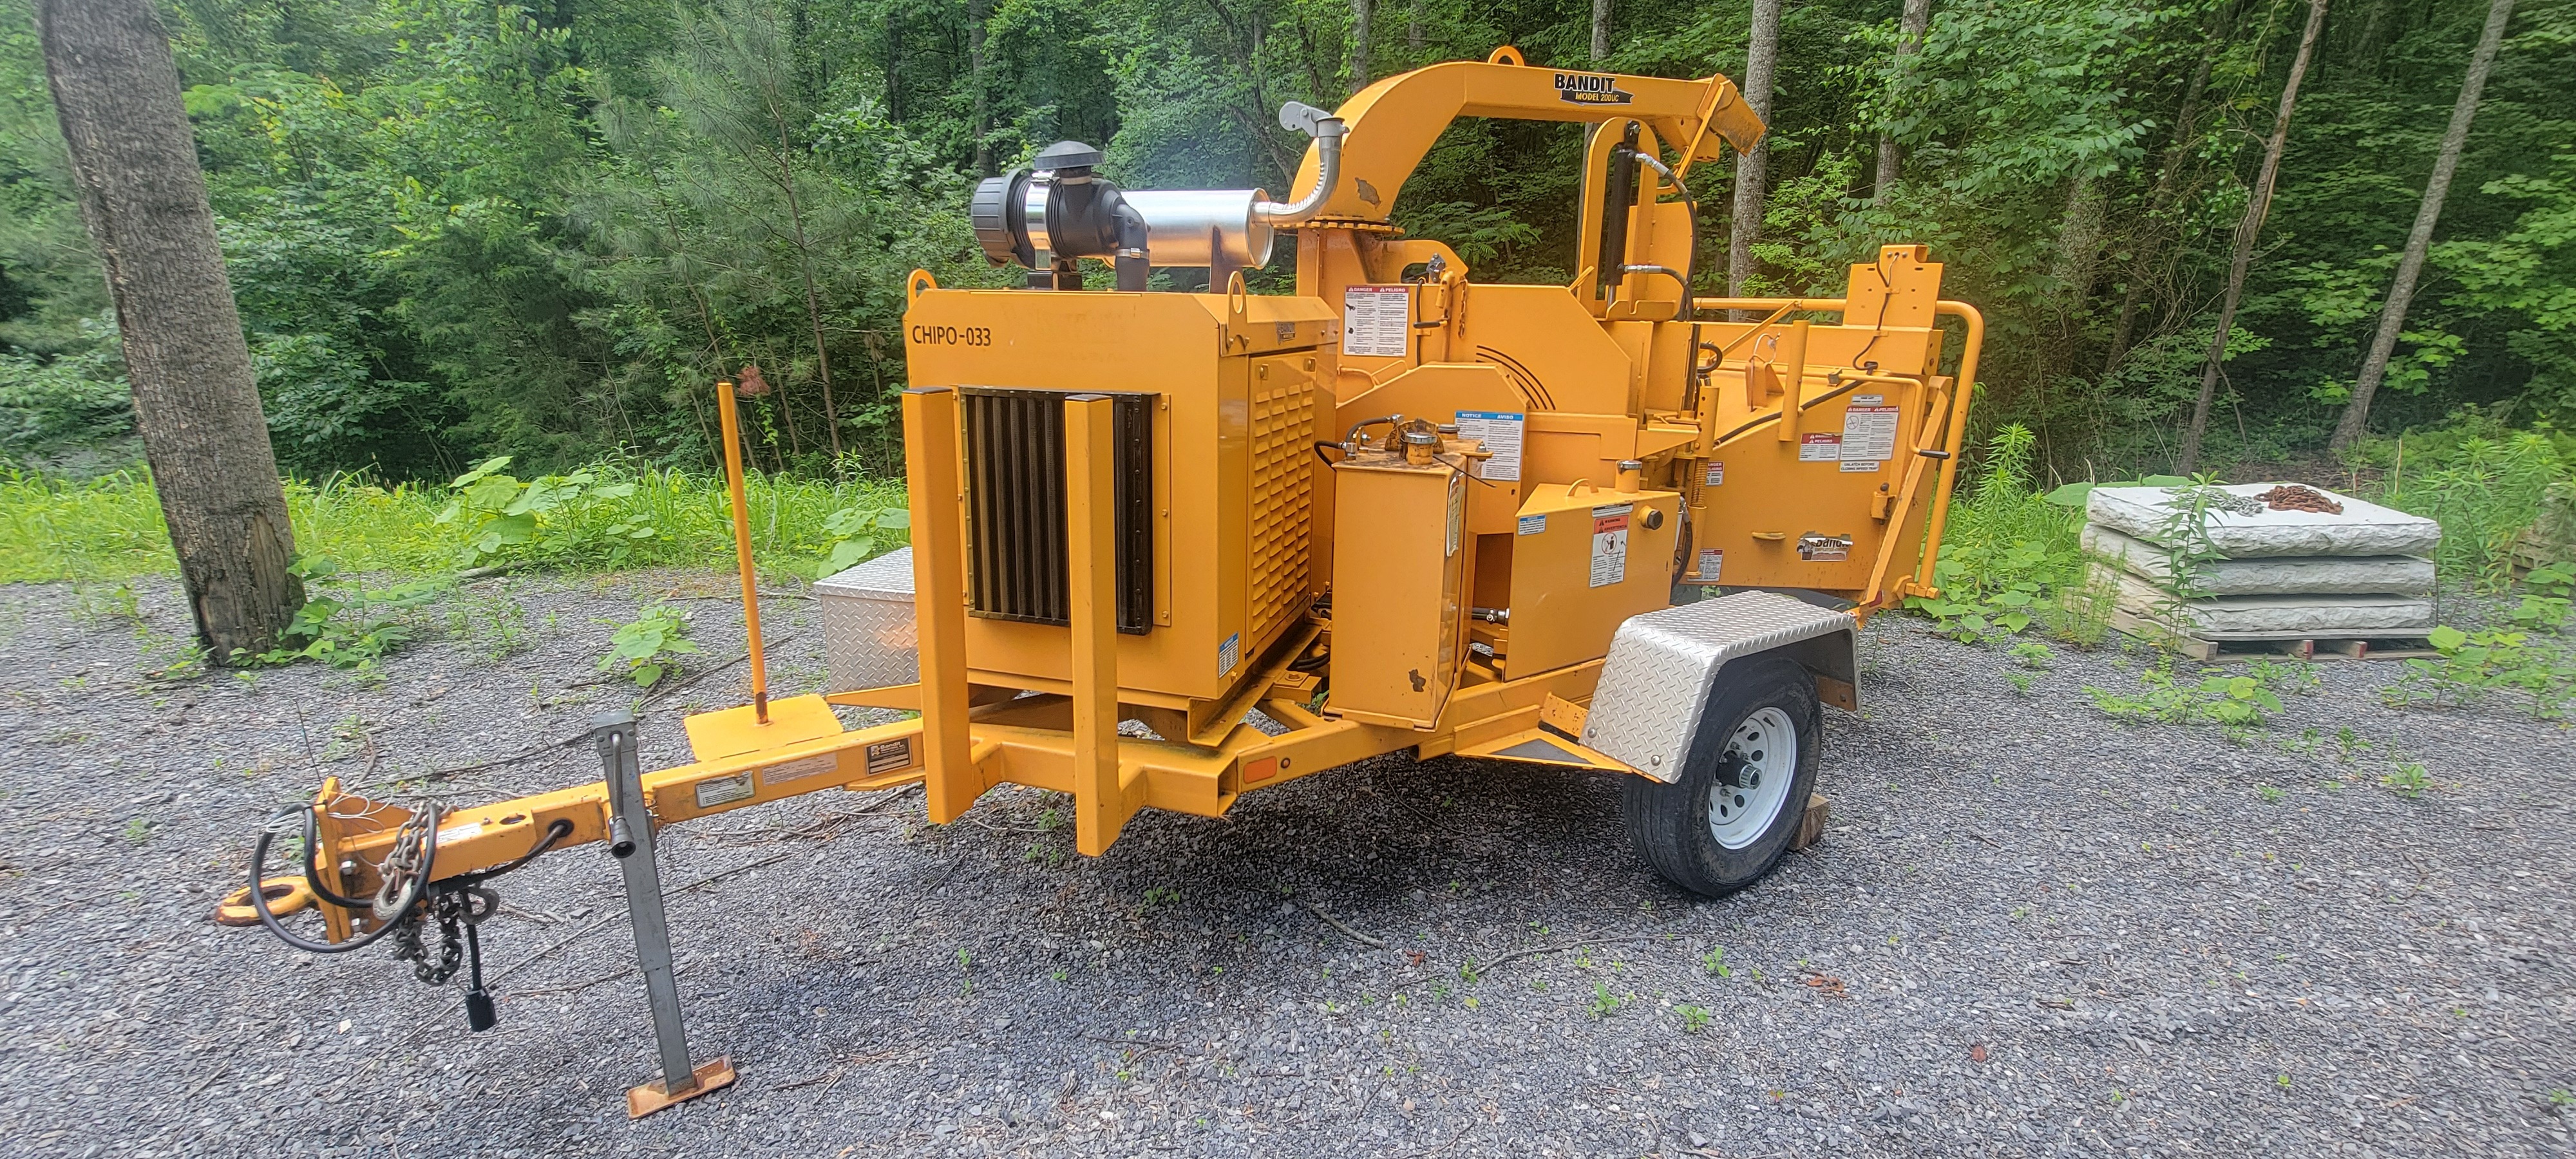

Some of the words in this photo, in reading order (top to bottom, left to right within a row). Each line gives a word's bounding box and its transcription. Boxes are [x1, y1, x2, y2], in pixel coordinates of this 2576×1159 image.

[1555, 73, 1615, 93] BANDIT
[1575, 93, 1599, 101] MODEL
[913, 325, 991, 346] CHIPO-033
